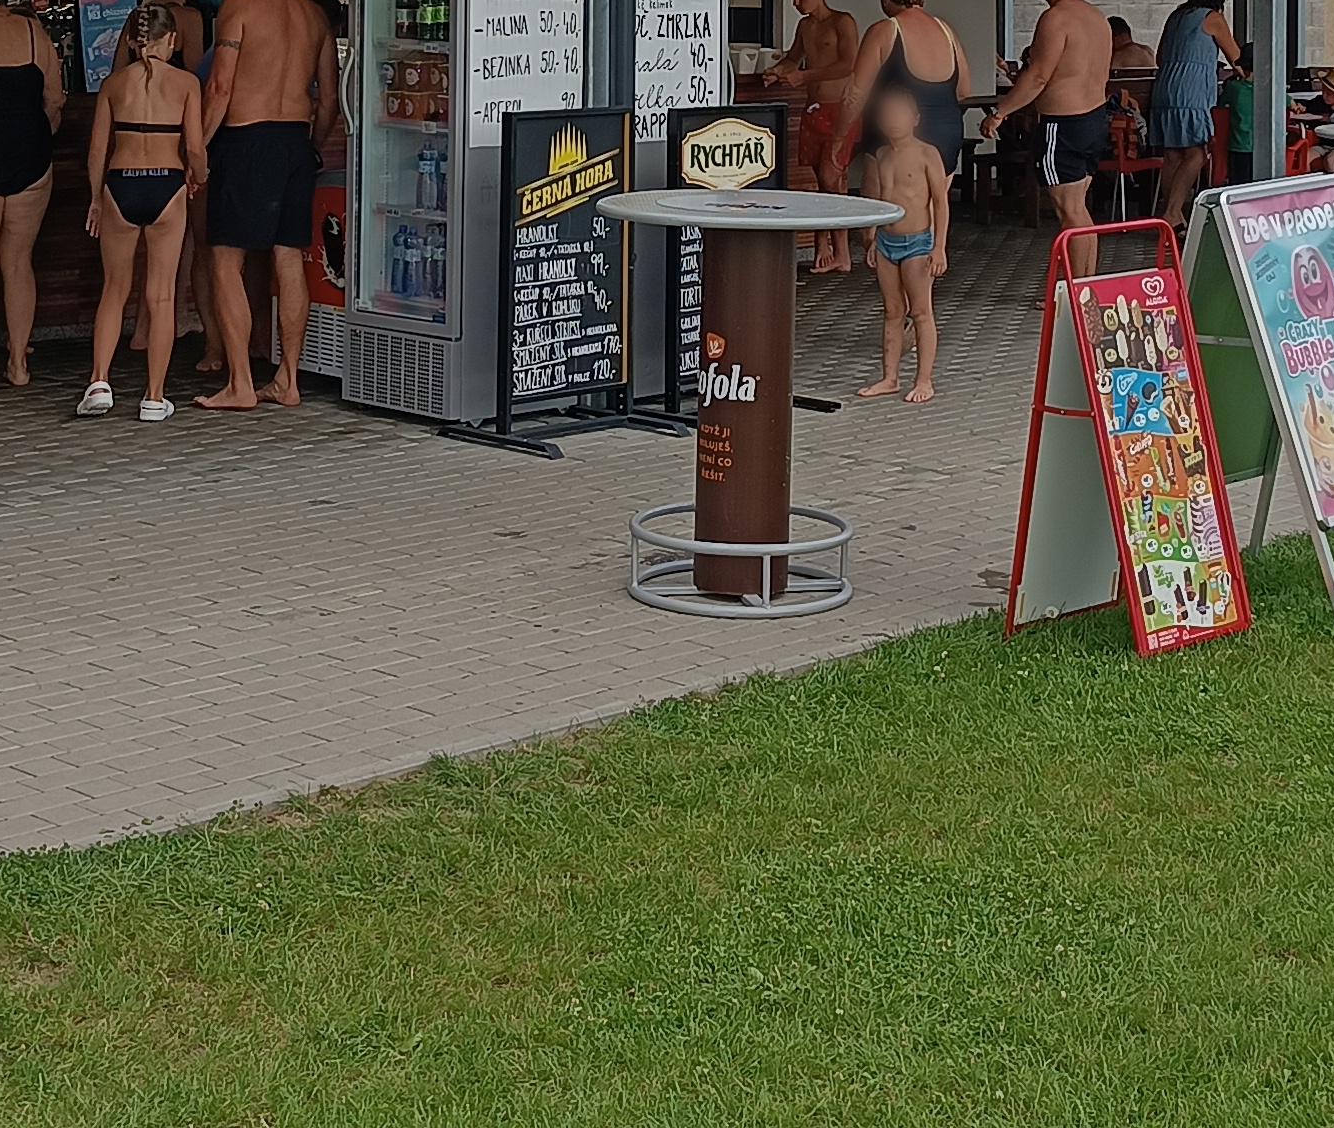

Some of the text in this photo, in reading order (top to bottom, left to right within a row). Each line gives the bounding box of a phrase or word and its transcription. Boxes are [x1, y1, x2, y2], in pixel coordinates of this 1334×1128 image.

[657, 12, 712, 40] ZMRZKA
[690, 43, 714, 73] 40,-
[688, 76, 714, 106] 50,-
[634, 113, 666, 139] RAPP
[690, 136, 771, 173] RYCHTÁŘ
[522, 159, 614, 214] ČERNÁ HORA
[592, 216, 610, 239] 50,-
[1268, 213, 1284, 238] V
[592, 358, 616, 380] 120,-
[698, 362, 757, 407] ofola
[717, 457, 732, 467] CO
